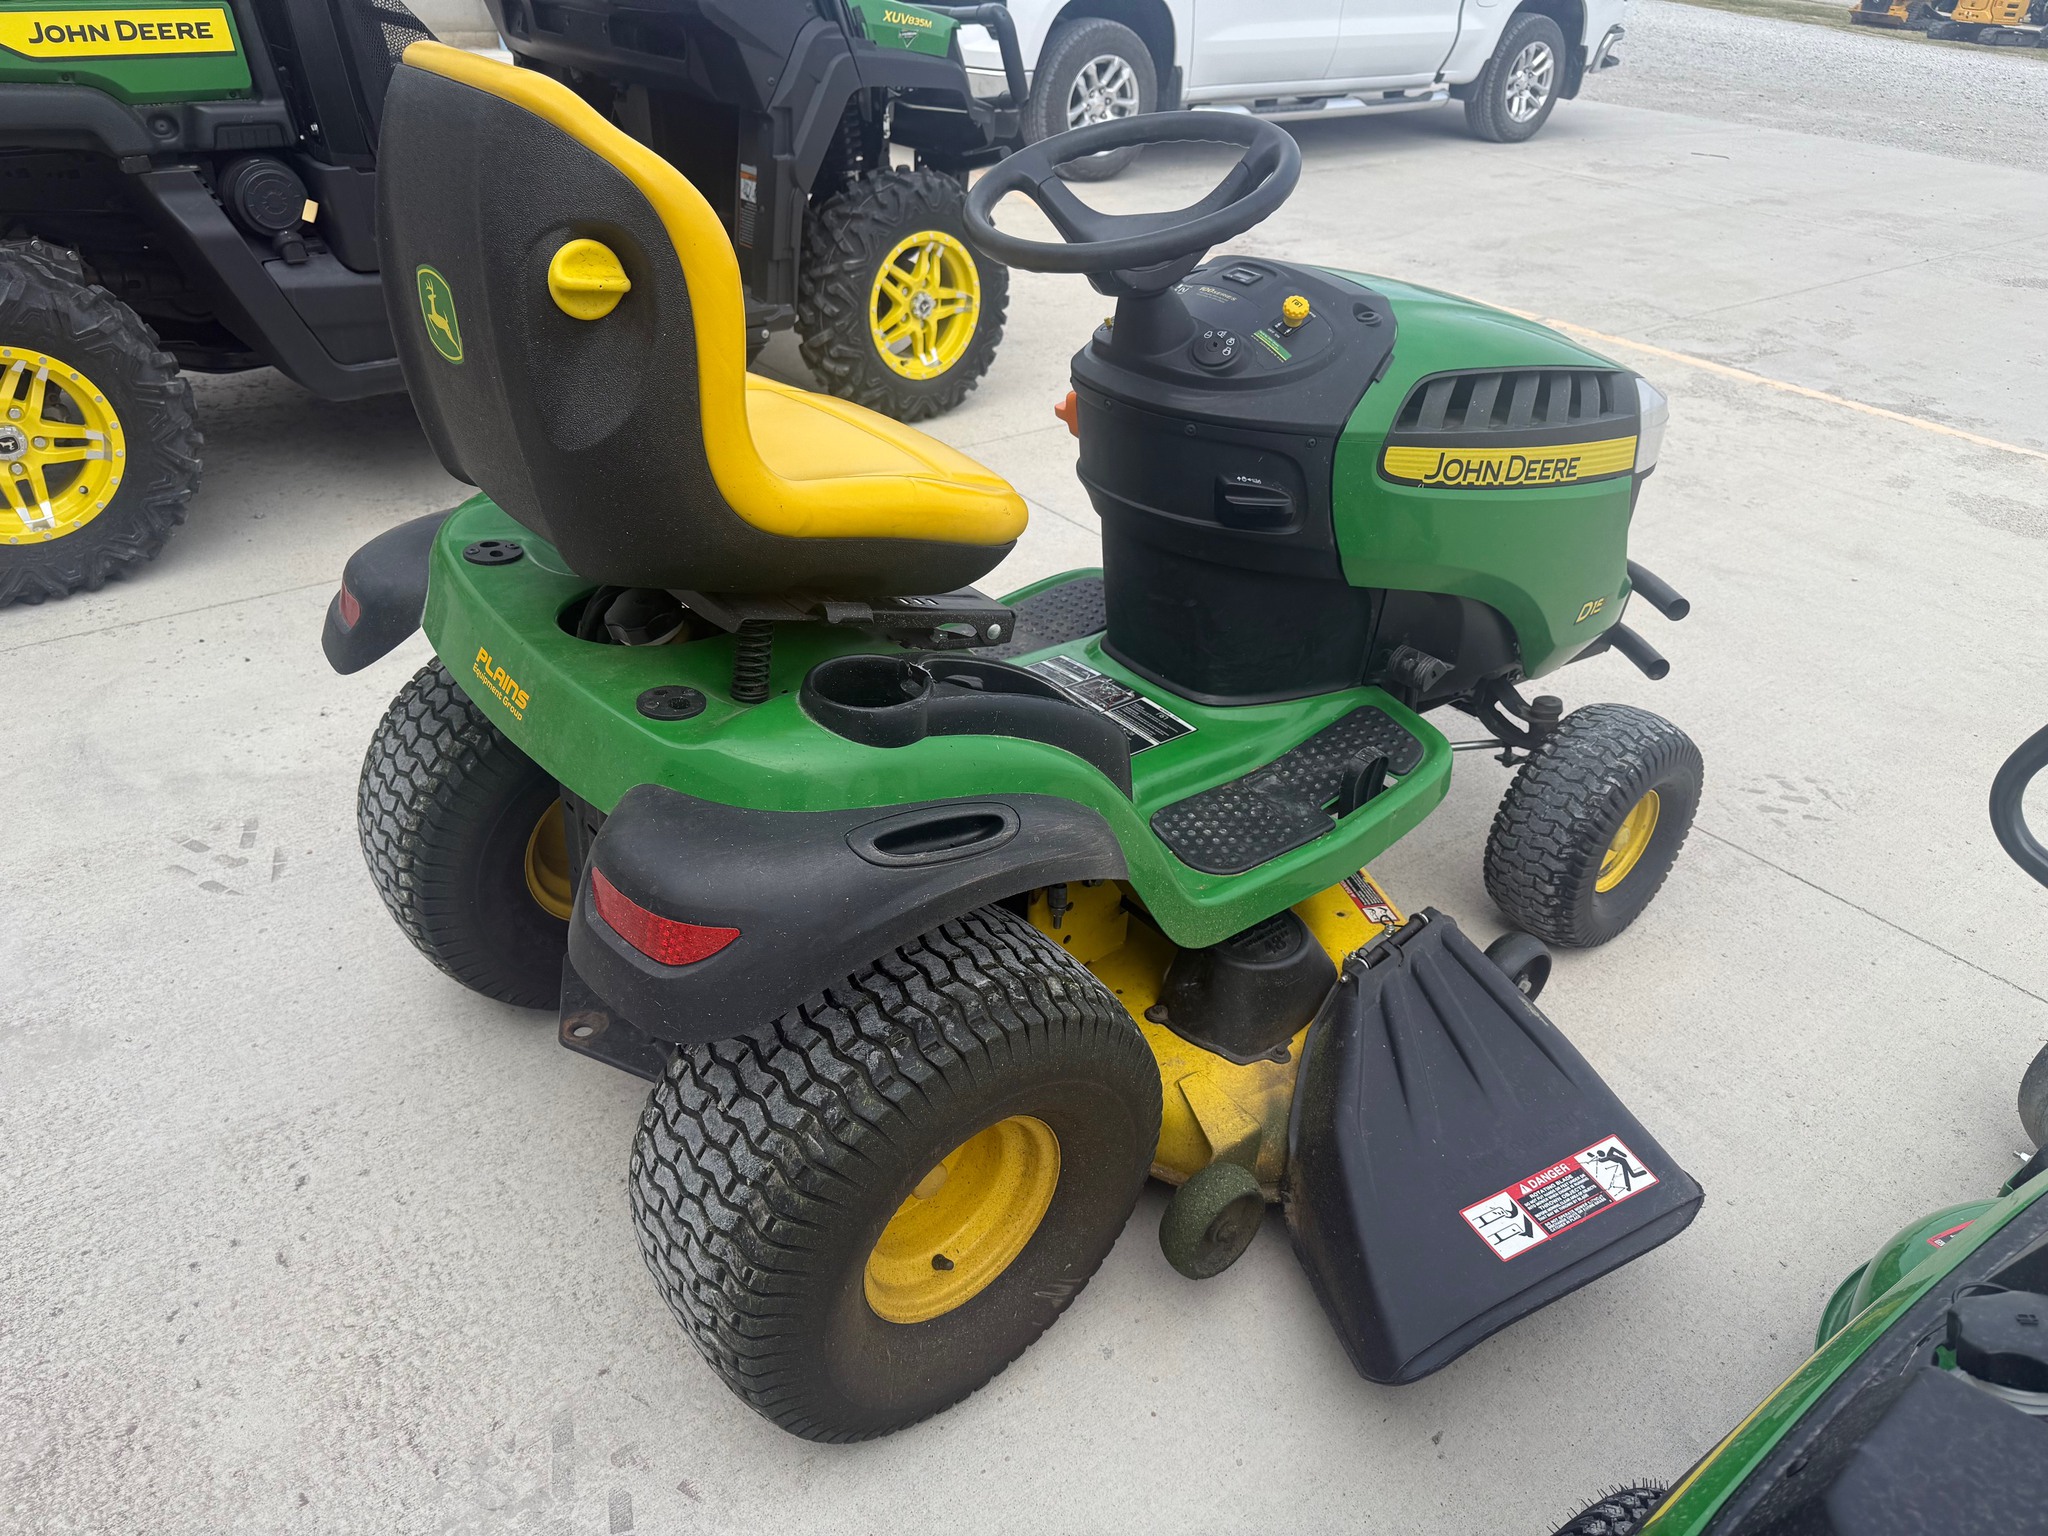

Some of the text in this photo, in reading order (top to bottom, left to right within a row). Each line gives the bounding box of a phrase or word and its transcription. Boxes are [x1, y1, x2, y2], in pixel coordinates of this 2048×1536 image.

[28, 20, 213, 44] JOHN DEERE
[883, 10, 932, 29] XUV835M
[1424, 452, 1581, 482] JOHN DEERE
[472, 662, 523, 721] Equipment Group
[476, 647, 530, 710] PLAINS
[1527, 1163, 1570, 1188] DANGER
[1529, 1174, 1573, 1198] ROTATING BLADE
[1538, 1184, 1586, 1211] THROWN OBJECTS
